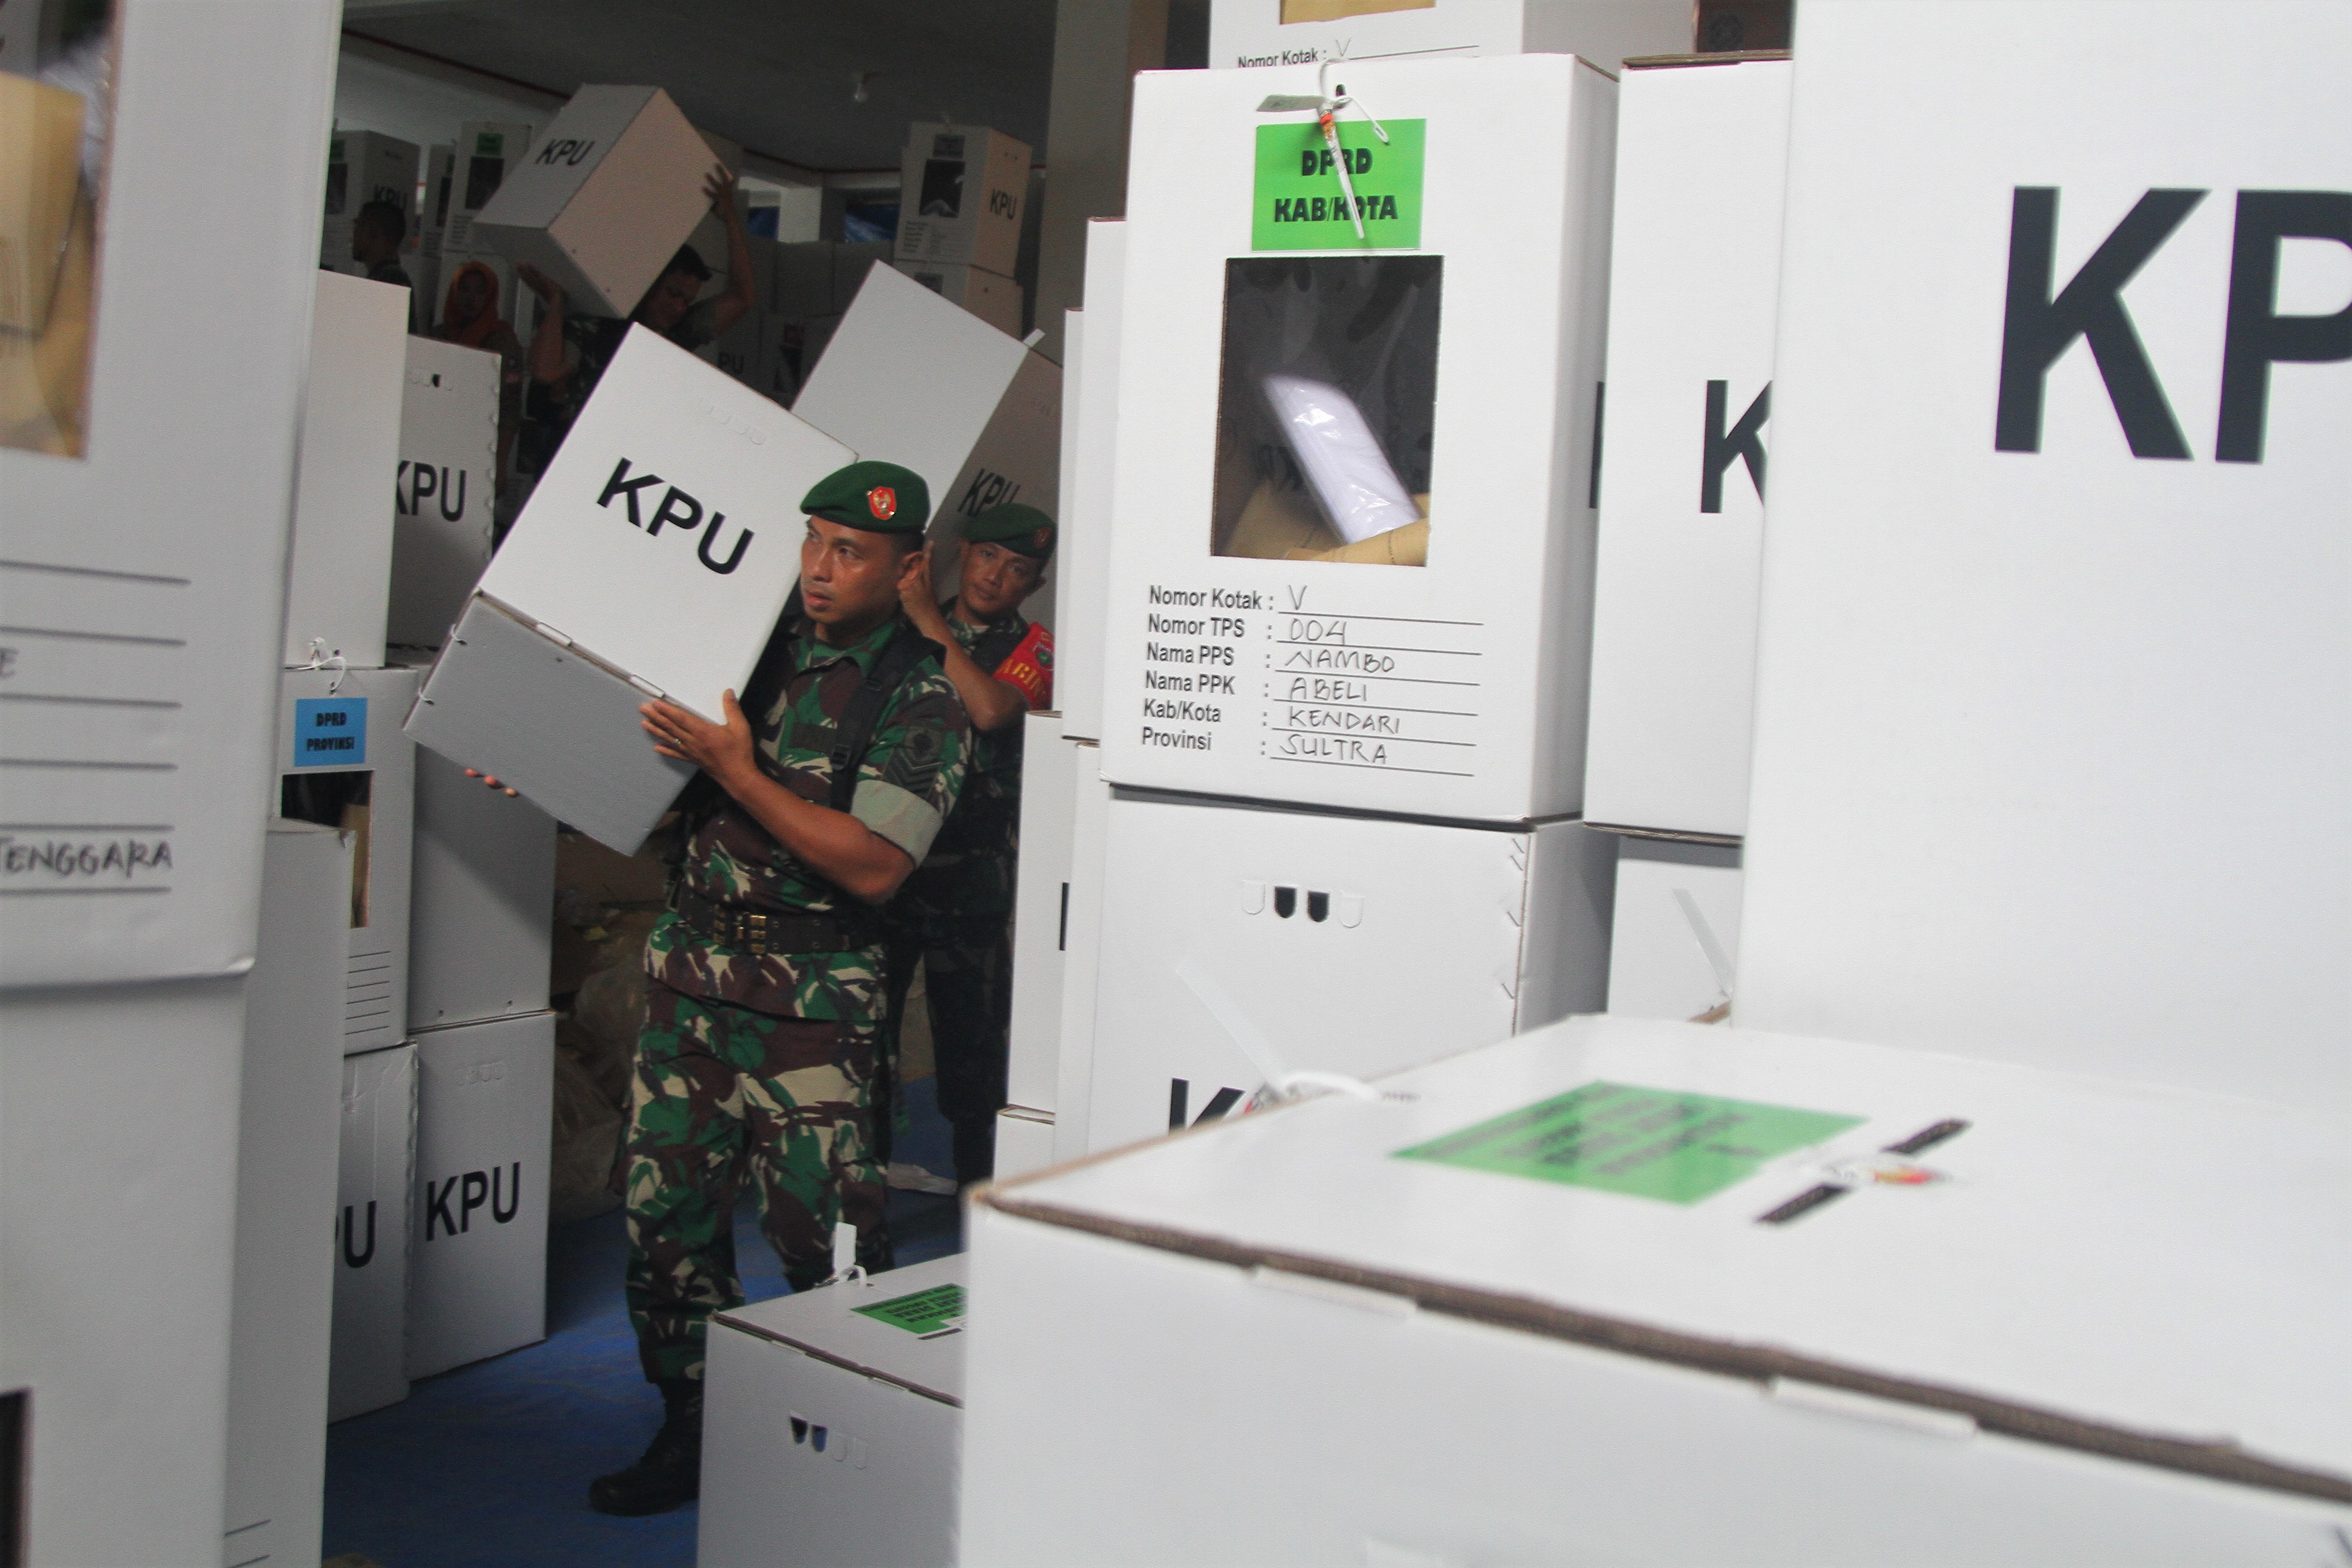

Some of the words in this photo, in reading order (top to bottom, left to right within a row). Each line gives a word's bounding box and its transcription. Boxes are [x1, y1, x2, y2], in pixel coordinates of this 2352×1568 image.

[1238, 54, 1279, 68] Nomor
[1282, 47, 1319, 65] Kotak
[1335, 37, 1352, 57] V
[534, 139, 595, 166] KPU
[1302, 148, 1373, 176] DPRD
[990, 188, 1018, 220] KPU
[596, 456, 755, 575] KPU
[1150, 585, 1207, 607] Nomor
[1212, 588, 1263, 610] Kotak
[1289, 584, 1308, 611] V
[1148, 613, 1206, 635] Nomor
[1210, 616, 1246, 638] TPS
[1147, 641, 1195, 663] Nama
[1200, 644, 1235, 666] PPS
[1285, 648, 1396, 673] NAMBO
[1146, 669, 1193, 692] Nama
[1199, 673, 1236, 695] PPK
[1290, 676, 1368, 702] ABELI
[315, 712, 348, 727] DPRD
[1144, 697, 1221, 722] Kab/Kota
[1289, 705, 1401, 735] KENDARI
[306, 736, 355, 751] PROVINSI
[1142, 726, 1213, 750] Provinsi
[1279, 733, 1388, 765] SULTRA
[426, 1161, 521, 1242] KPU
